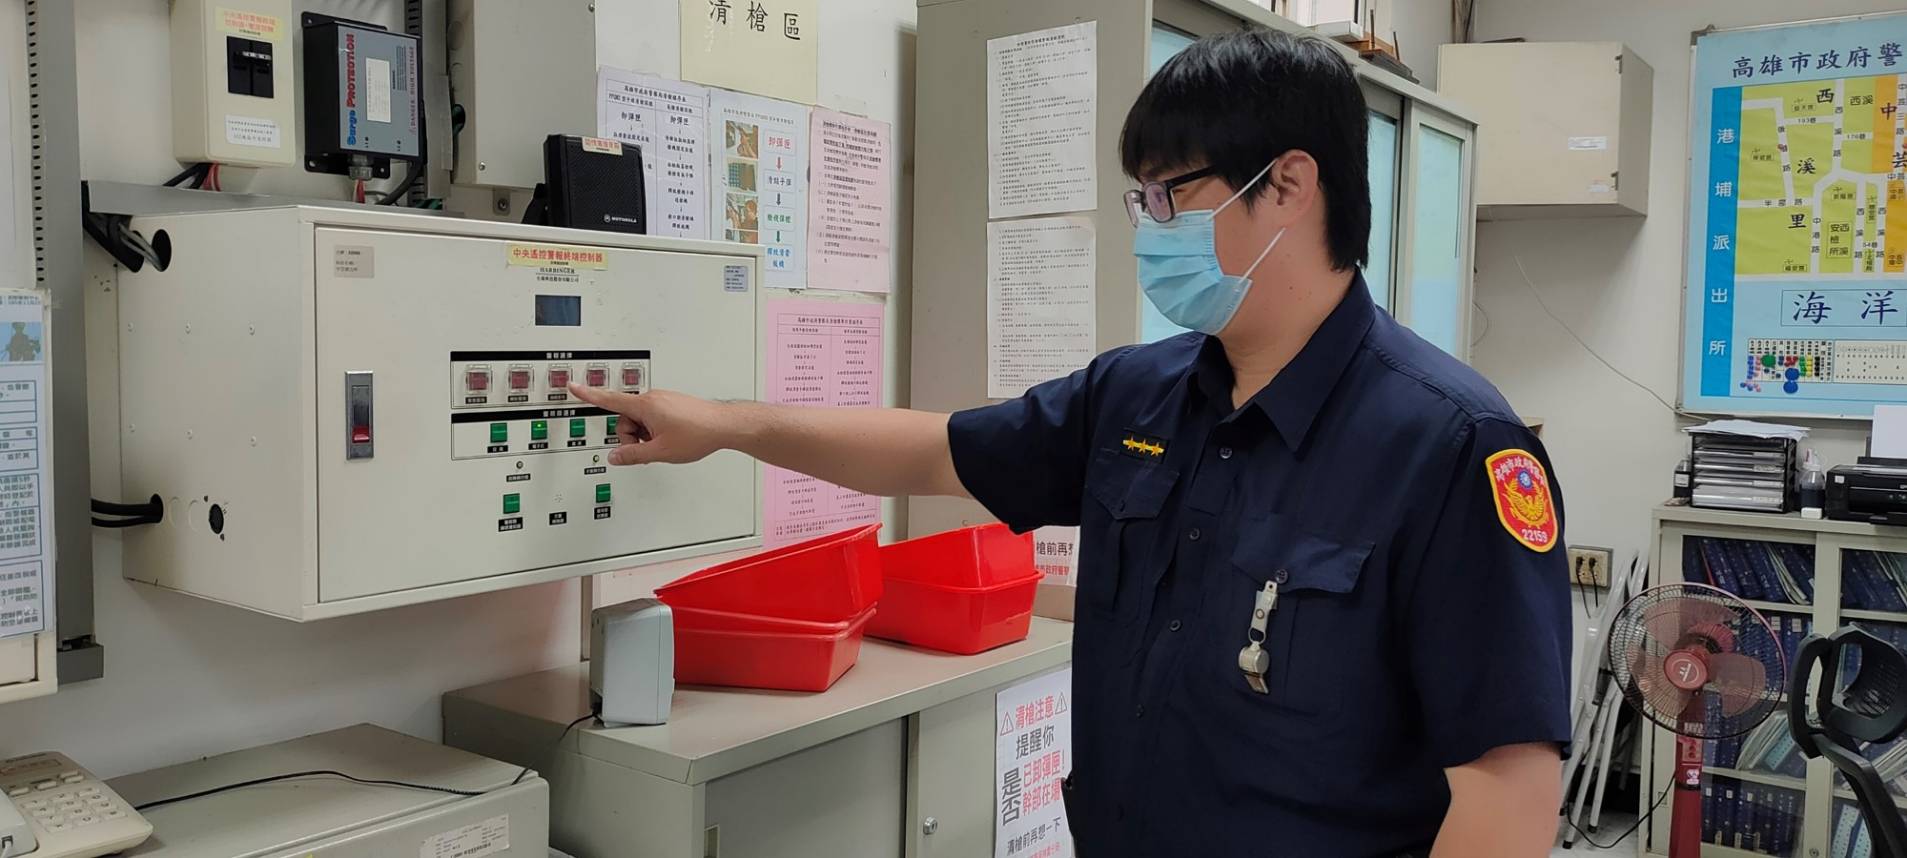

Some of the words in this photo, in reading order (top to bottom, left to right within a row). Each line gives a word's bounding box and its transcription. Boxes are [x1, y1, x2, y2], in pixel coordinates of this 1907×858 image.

[709, 0, 801, 40] 清槍區
[345, 33, 356, 108] PROTECTION
[1732, 43, 1902, 78] 高雄市政府警
[1708, 128, 1737, 357] 港埔派出所
[1792, 290, 1899, 325] 海洋
[1015, 696, 1054, 729] 清槍注意
[1015, 723, 1055, 760] 提醒你
[1001, 767, 1022, 826] 是否
